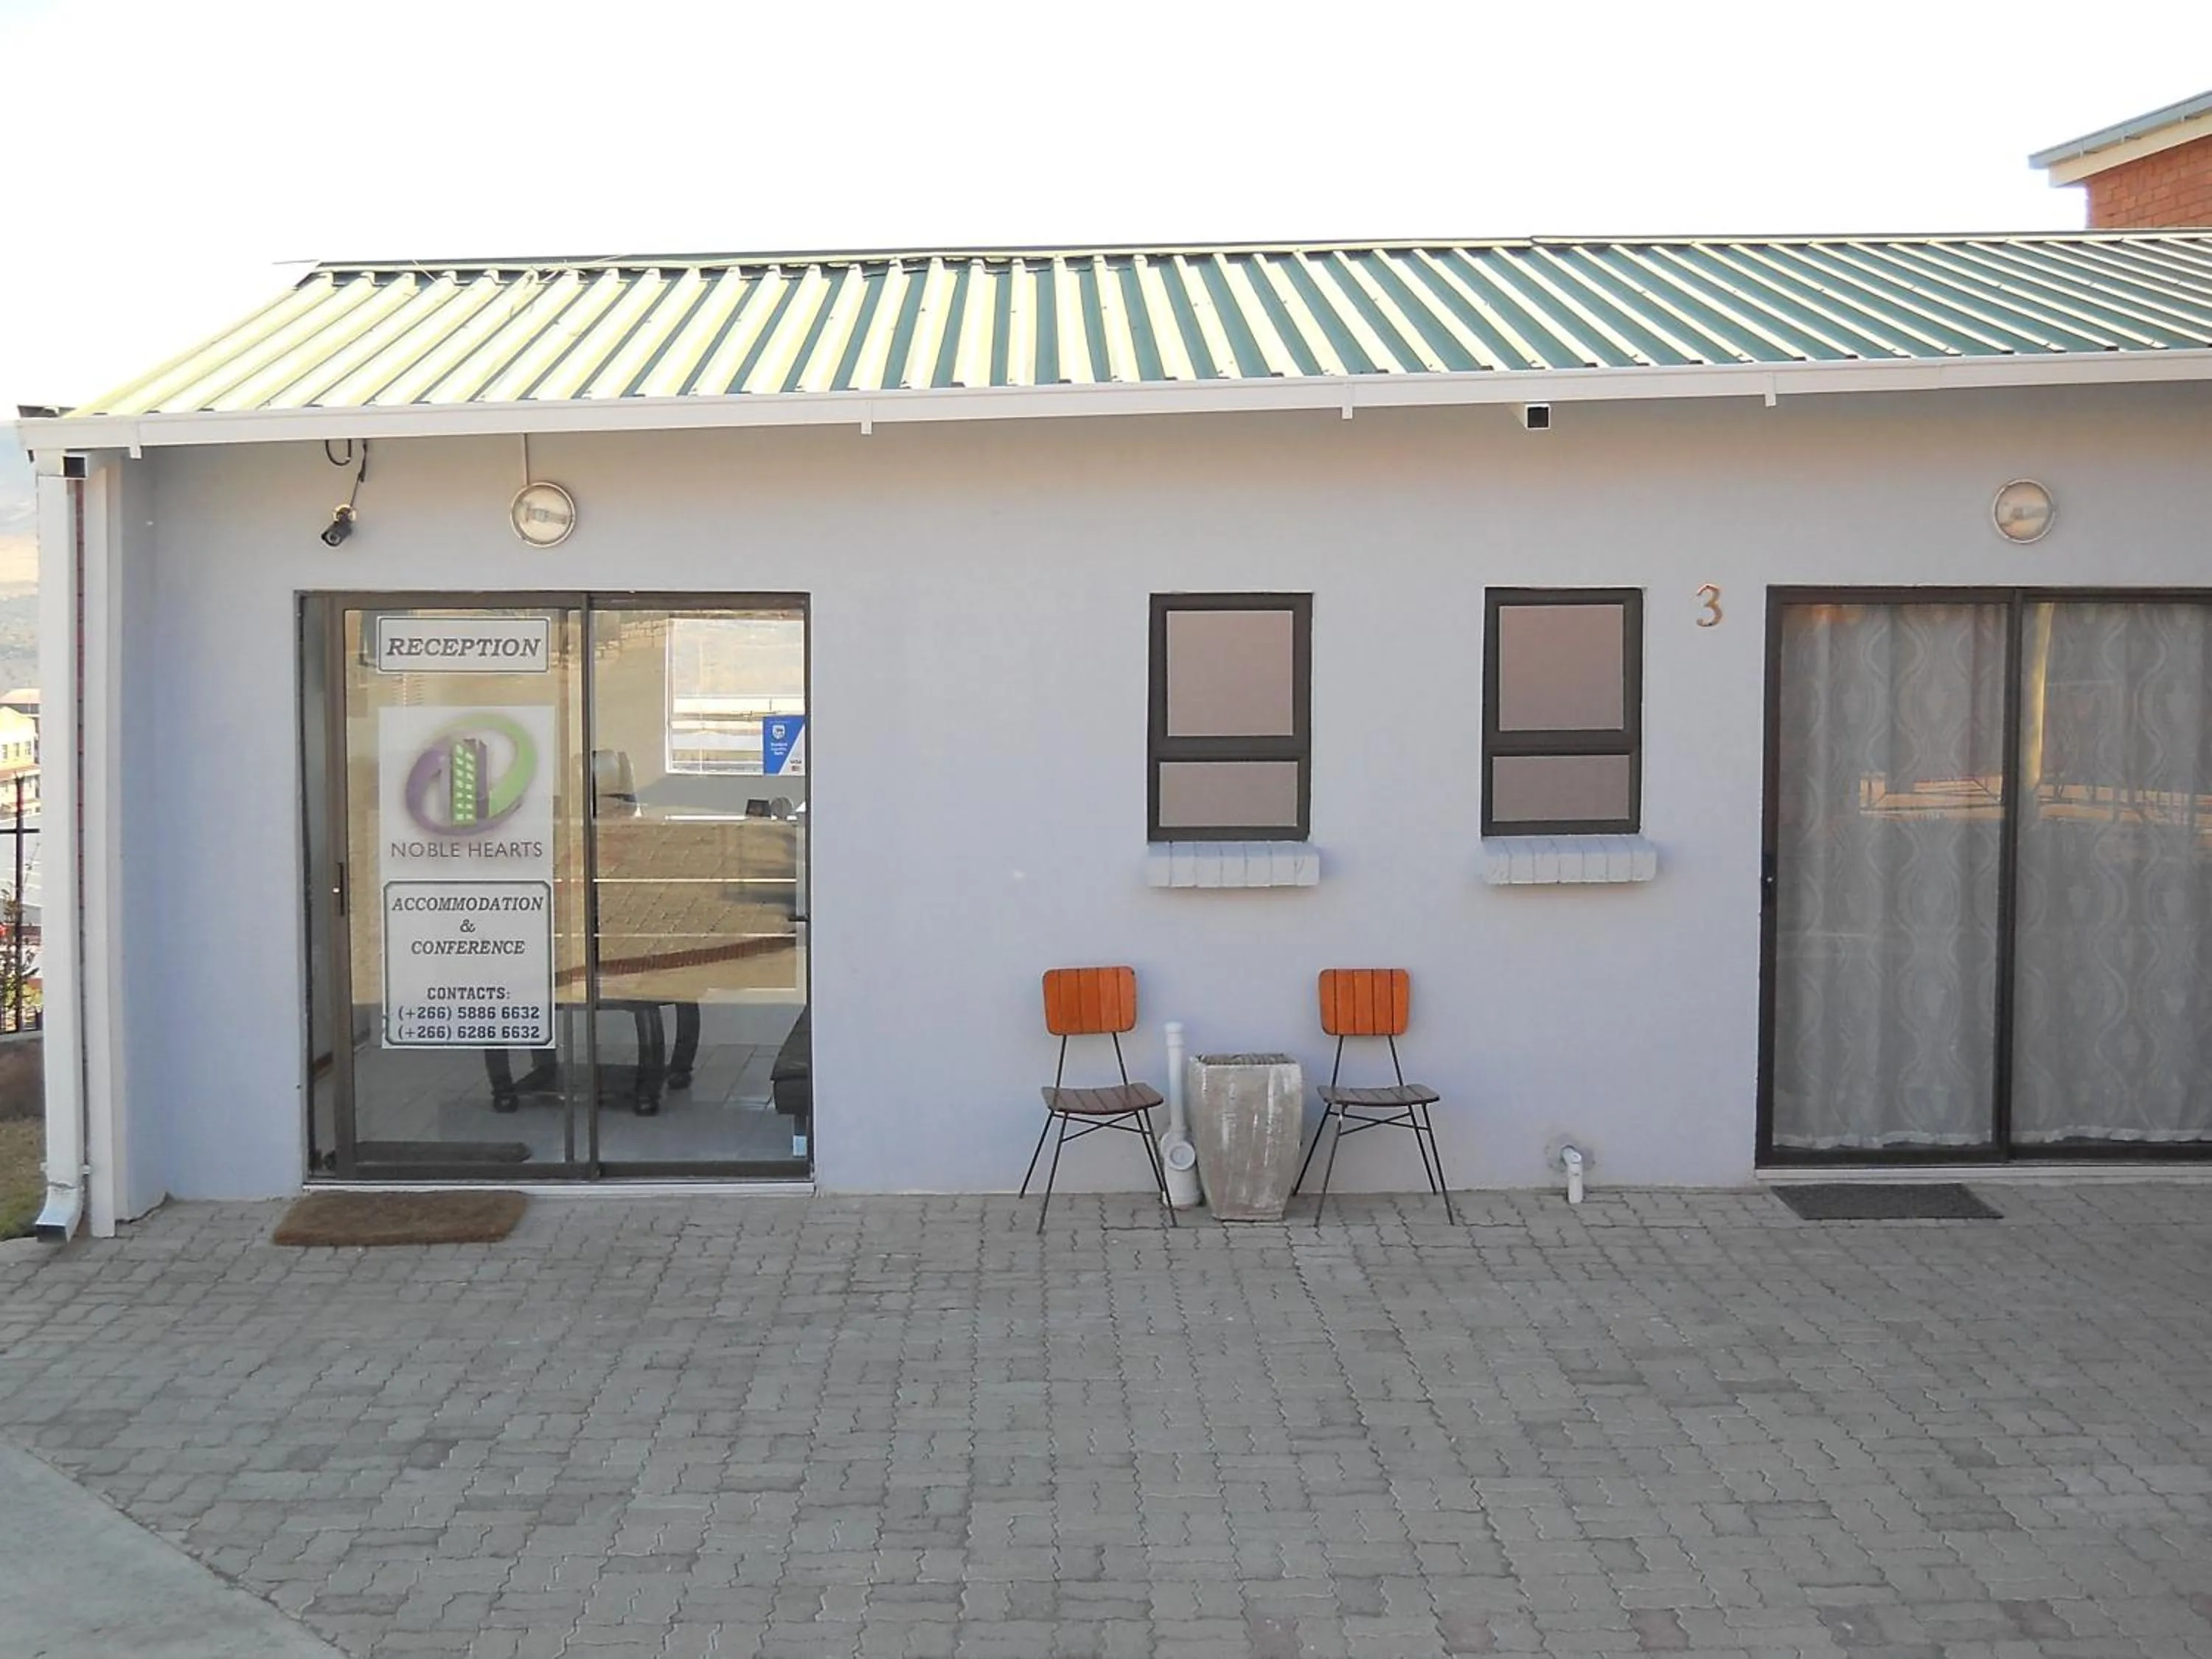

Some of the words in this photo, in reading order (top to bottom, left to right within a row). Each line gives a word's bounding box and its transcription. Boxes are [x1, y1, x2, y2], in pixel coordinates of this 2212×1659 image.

[1696, 583, 1722, 627] 3
[386, 638, 542, 657] RECEPTION
[391, 842, 461, 858] NOBLE
[468, 842, 543, 858] HEARTS
[392, 897, 543, 911] ACCOMMODATION
[459, 919, 476, 933] &
[411, 940, 526, 955] CONFERENCE
[427, 987, 511, 1001] CONTACTS:
[397, 1006, 452, 1021] (+266)
[457, 1006, 496, 1020] 5886
[501, 1006, 540, 1020] 6632
[397, 1025, 452, 1040] (+266)
[457, 1026, 496, 1039] 6286
[501, 1026, 540, 1039] 6632
